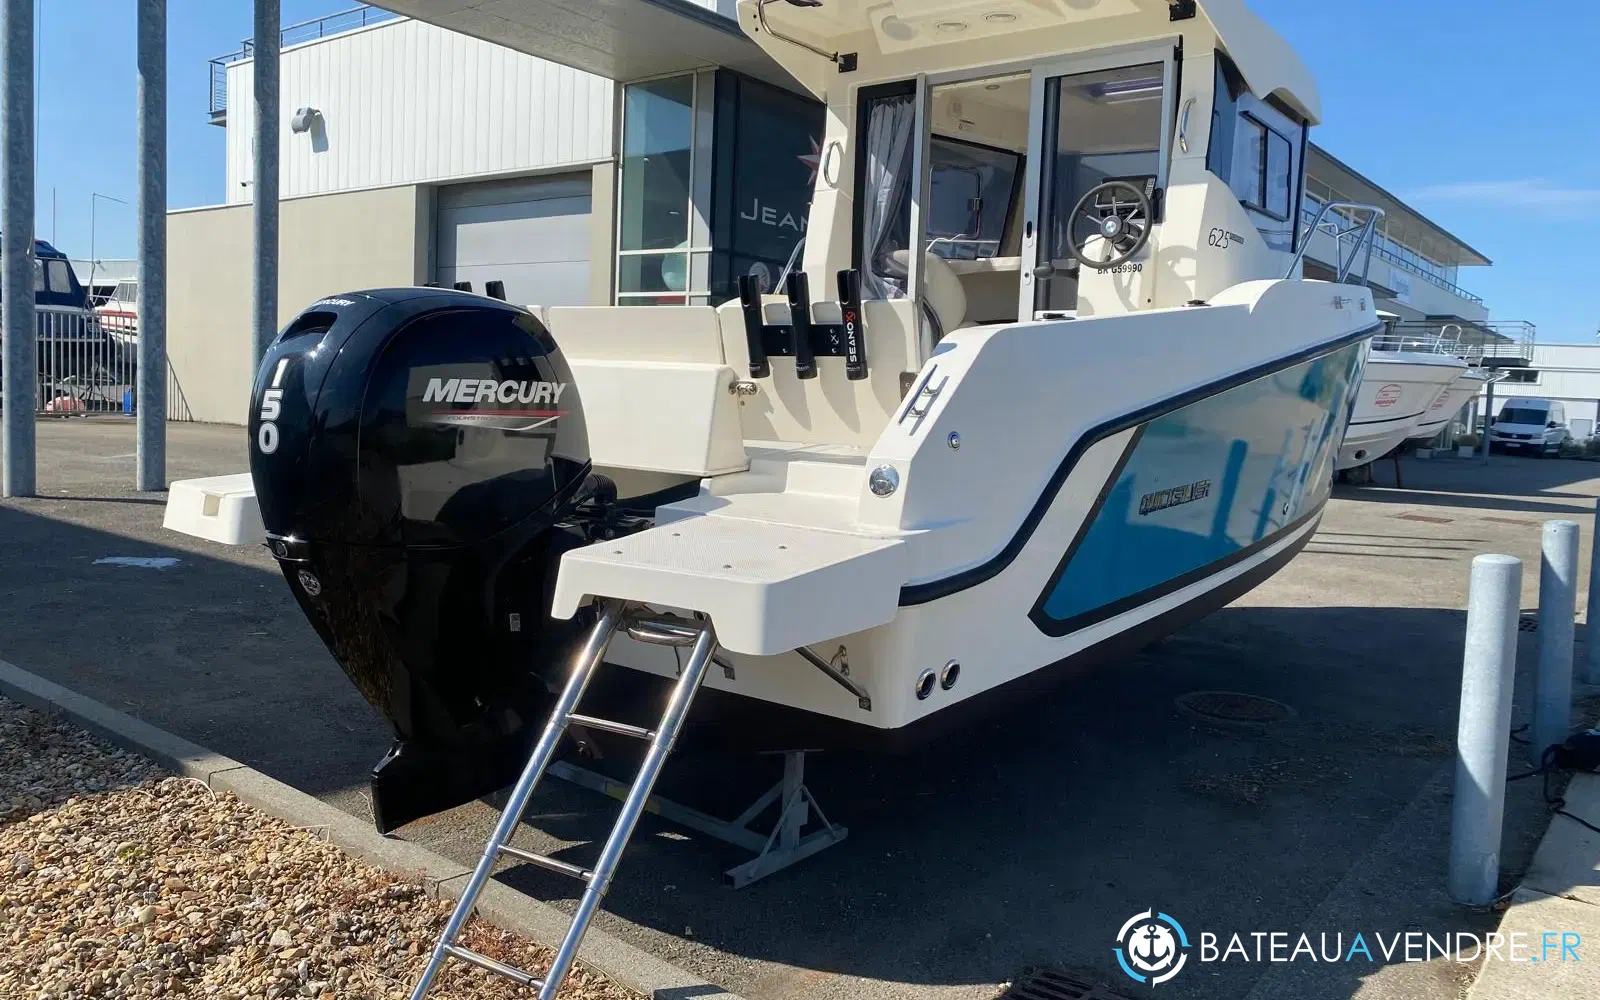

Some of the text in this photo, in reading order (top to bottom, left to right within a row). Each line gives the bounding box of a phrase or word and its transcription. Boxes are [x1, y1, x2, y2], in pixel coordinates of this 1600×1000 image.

[1208, 227, 1230, 249] 625
[1111, 263, 1143, 274] G59990
[422, 378, 567, 404] MERCURY
[258, 358, 289, 455] 150
